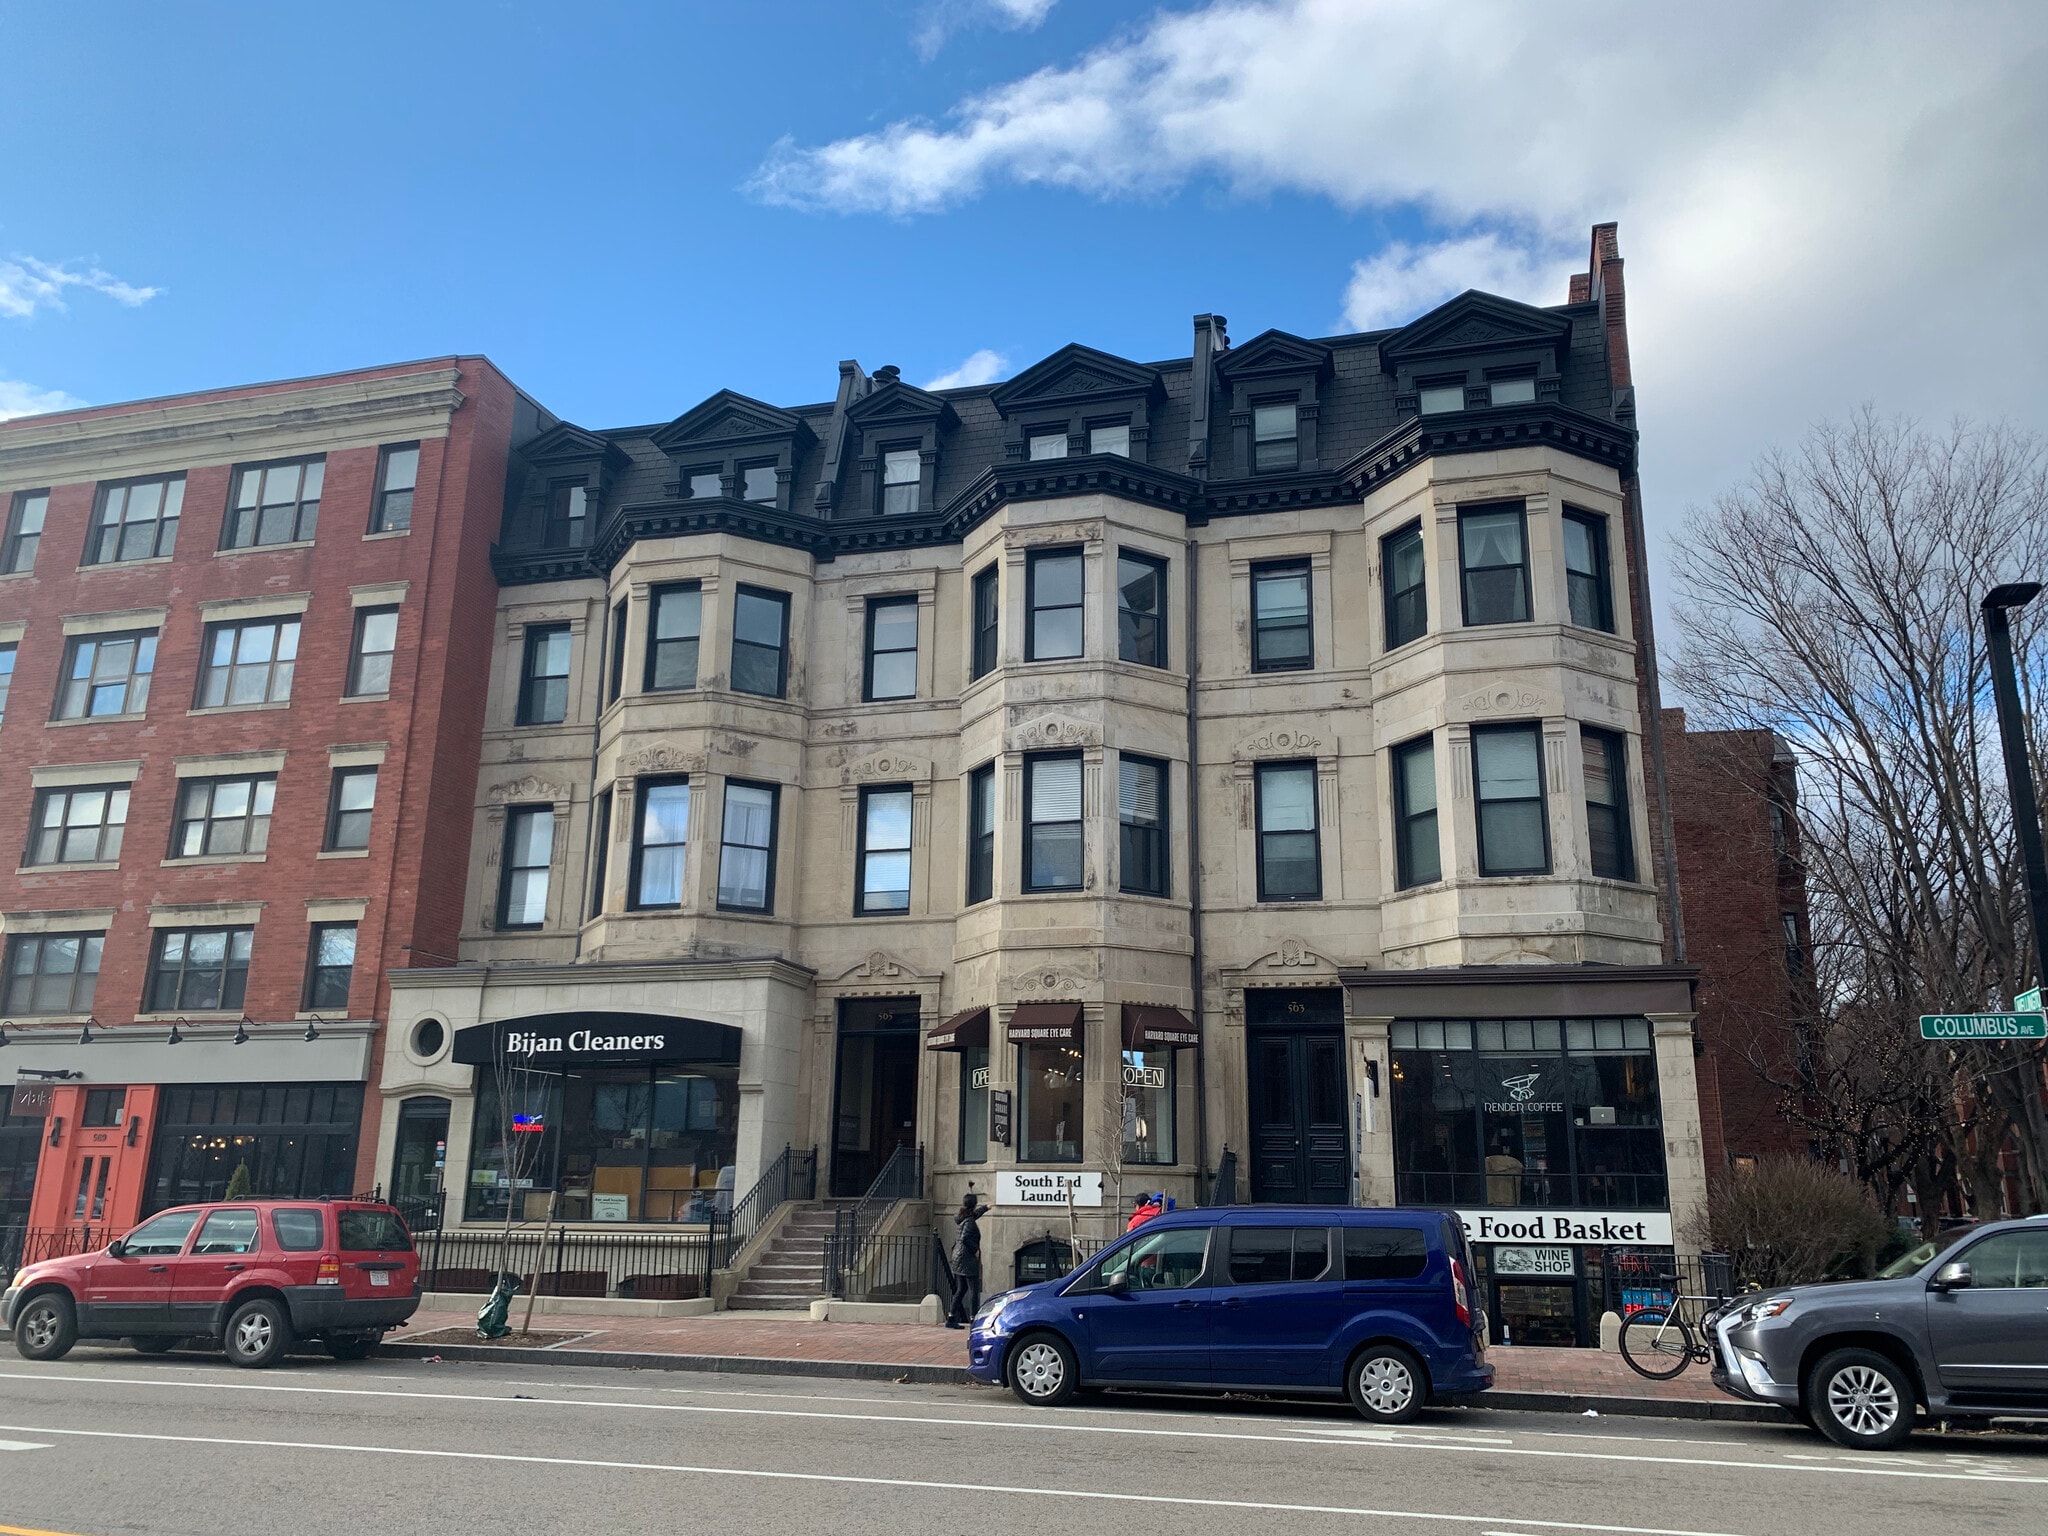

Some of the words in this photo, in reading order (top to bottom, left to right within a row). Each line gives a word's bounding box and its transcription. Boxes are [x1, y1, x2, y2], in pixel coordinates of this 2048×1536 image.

[1933, 1017, 2018, 1036] COLUMBUS
[2020, 1025, 2035, 1035] AVE
[1008, 1028, 1031, 1038] HARVARD
[1031, 1028, 1049, 1039] SQUARE
[1050, 1028, 1059, 1038] EYE
[1060, 1028, 1072, 1037] CARE
[1144, 1030, 1164, 1041] HARVARD
[1164, 1031, 1180, 1042] SQUARE
[1180, 1032, 1188, 1043] EYE
[1188, 1033, 1199, 1043] CARE
[506, 1032, 563, 1058] Bijan
[568, 1030, 665, 1051] Cleaners
[974, 1069, 989, 1086] OPE
[1124, 1067, 1163, 1086] OPEN
[1484, 1102, 1525, 1114] RENDER
[1527, 1102, 1564, 1112] COFFEE
[1015, 1175, 1053, 1188] South
[1478, 1216, 1546, 1239] Food
[1553, 1217, 1647, 1241] Basket
[1534, 1250, 1569, 1261] WINE
[1534, 1261, 1571, 1273] SHOP
